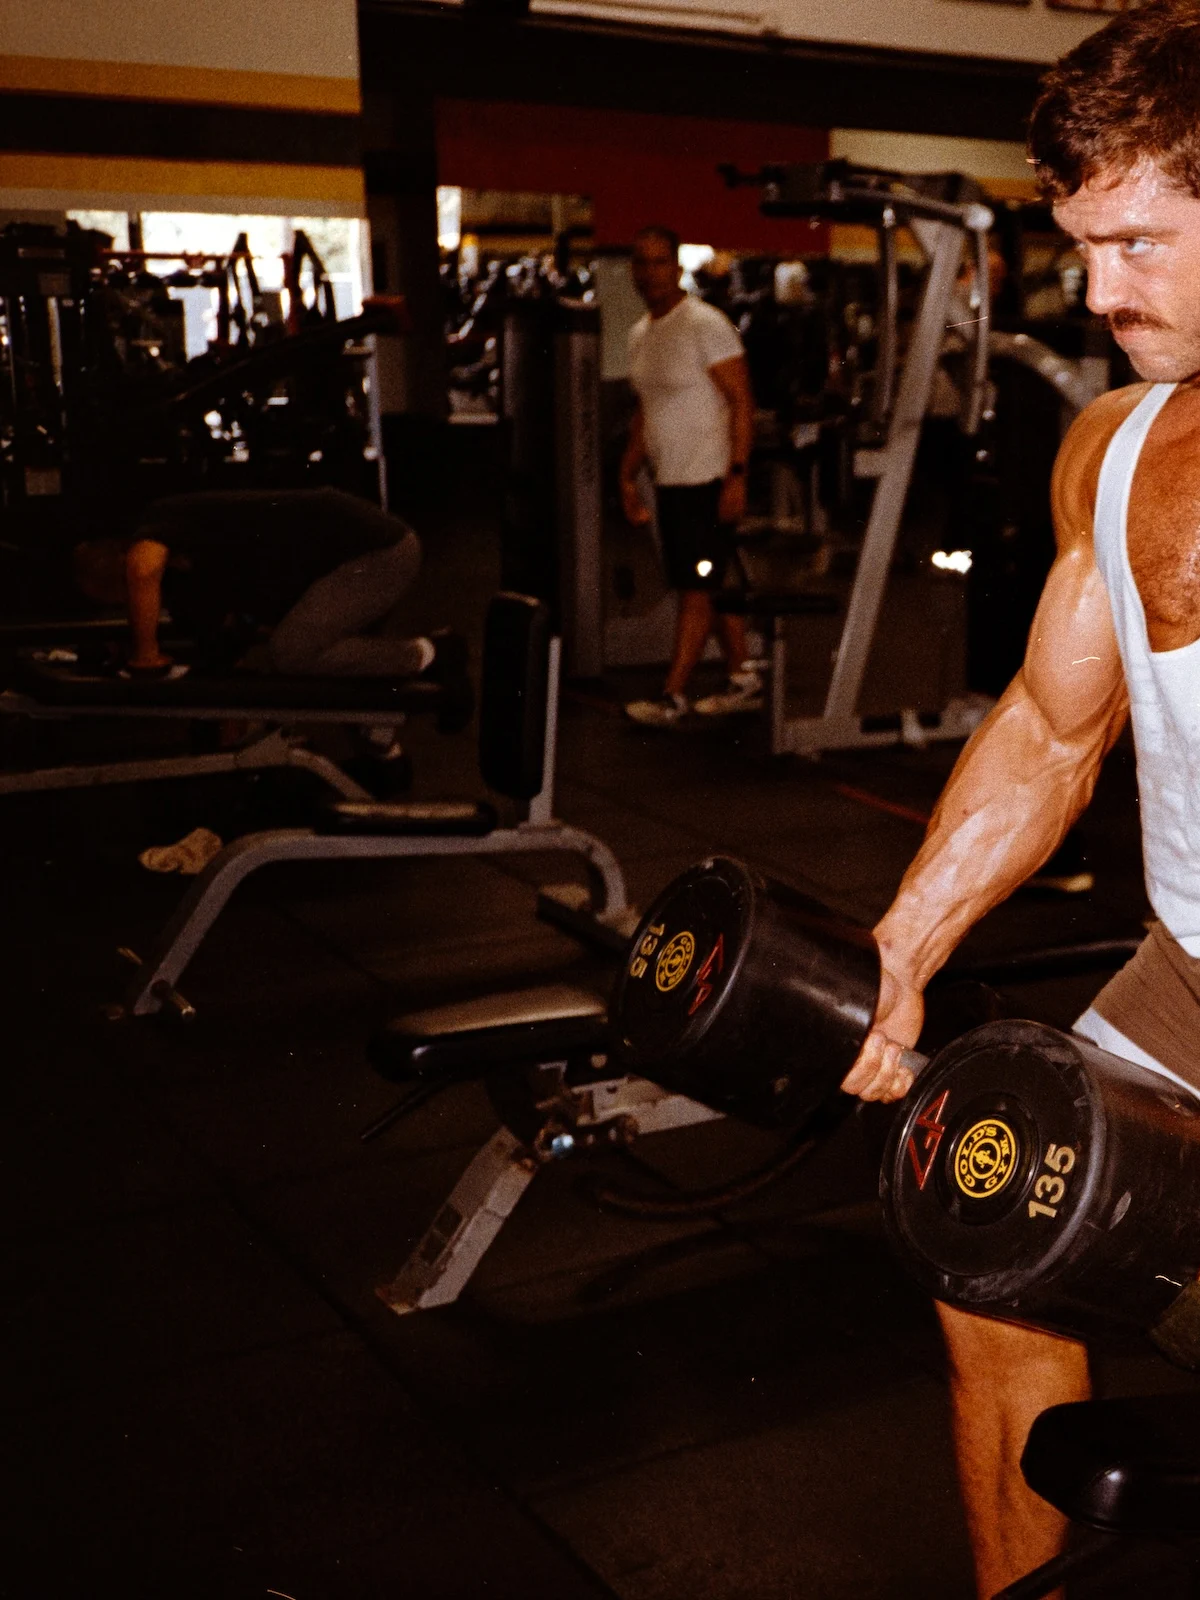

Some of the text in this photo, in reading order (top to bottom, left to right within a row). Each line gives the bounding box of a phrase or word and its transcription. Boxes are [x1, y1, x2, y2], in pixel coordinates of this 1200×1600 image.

[629, 923, 666, 979] 135
[959, 1125, 998, 1189] GOLD'S
[1027, 1143, 1077, 1220] 135
